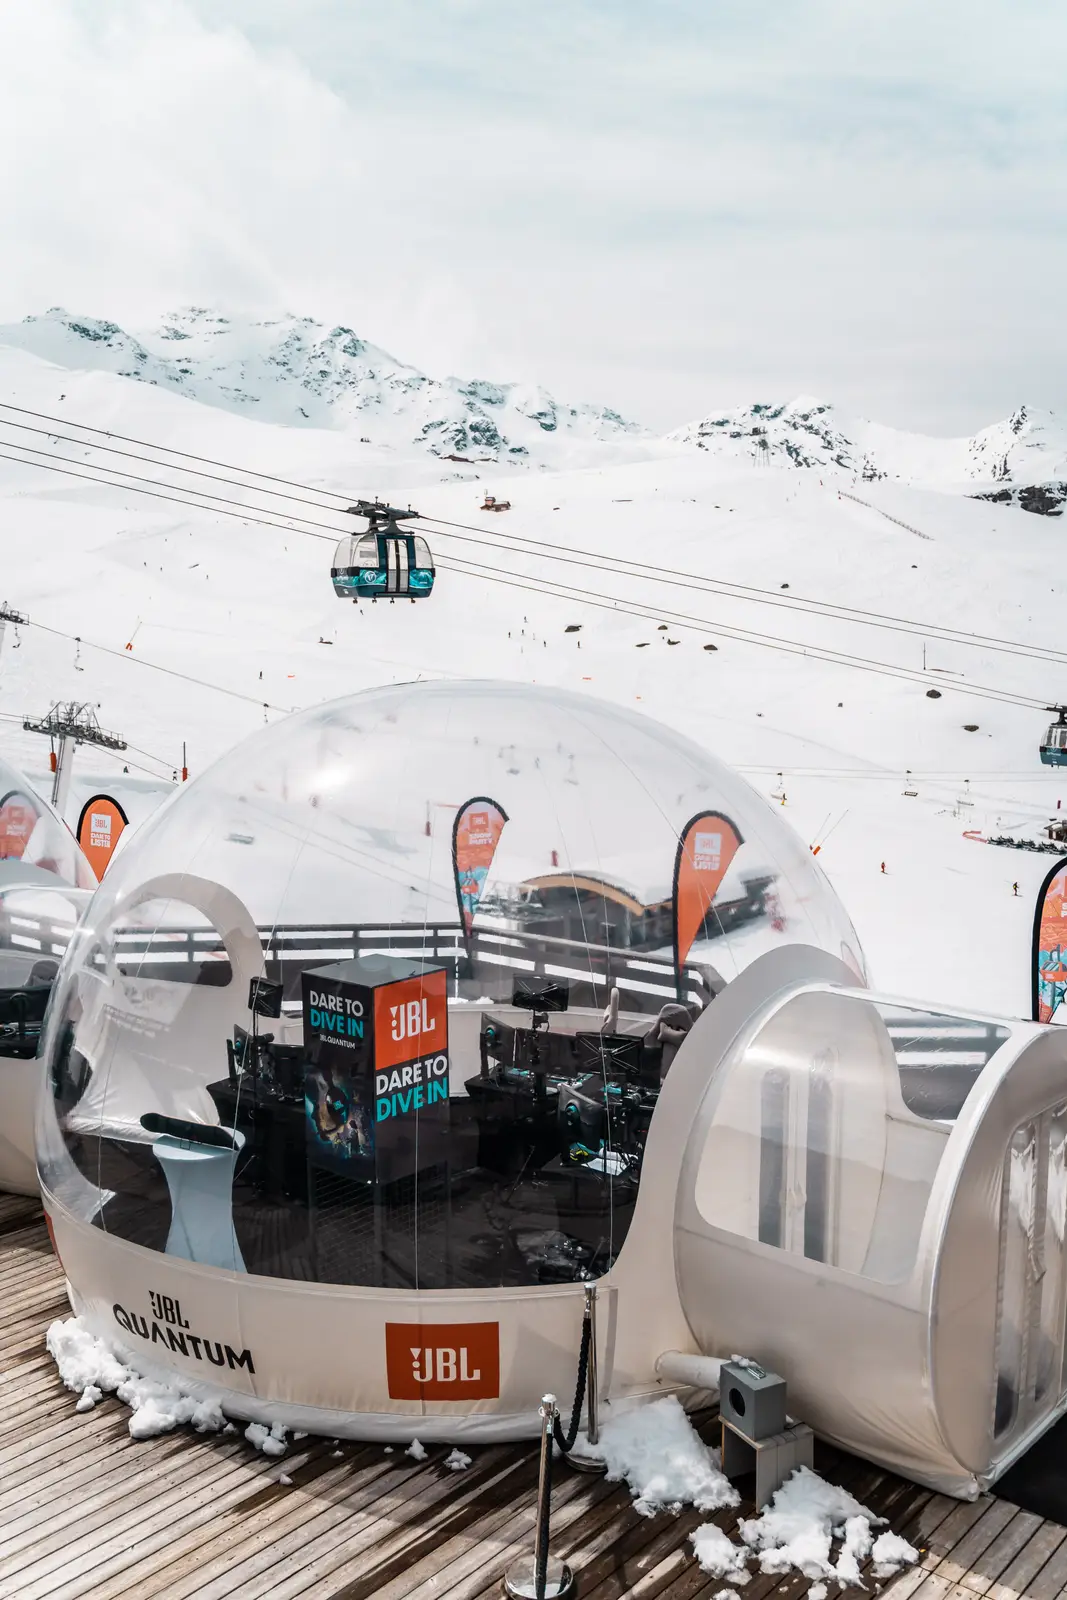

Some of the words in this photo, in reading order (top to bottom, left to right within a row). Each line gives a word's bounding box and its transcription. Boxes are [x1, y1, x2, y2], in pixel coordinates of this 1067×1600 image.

[310, 990, 344, 1012] DARE
[344, 998, 364, 1017] TO
[310, 1008, 345, 1034] DIVE
[347, 1018, 364, 1038] IN
[390, 998, 436, 1041] JBL
[375, 1062, 422, 1095] DARE
[424, 1055, 448, 1079] TO
[376, 1085, 424, 1122] DIVE
[427, 1077, 447, 1104] IN
[148, 1290, 190, 1329] JBL
[112, 1303, 256, 1374] QUANTUM
[409, 1347, 481, 1382] JBL
